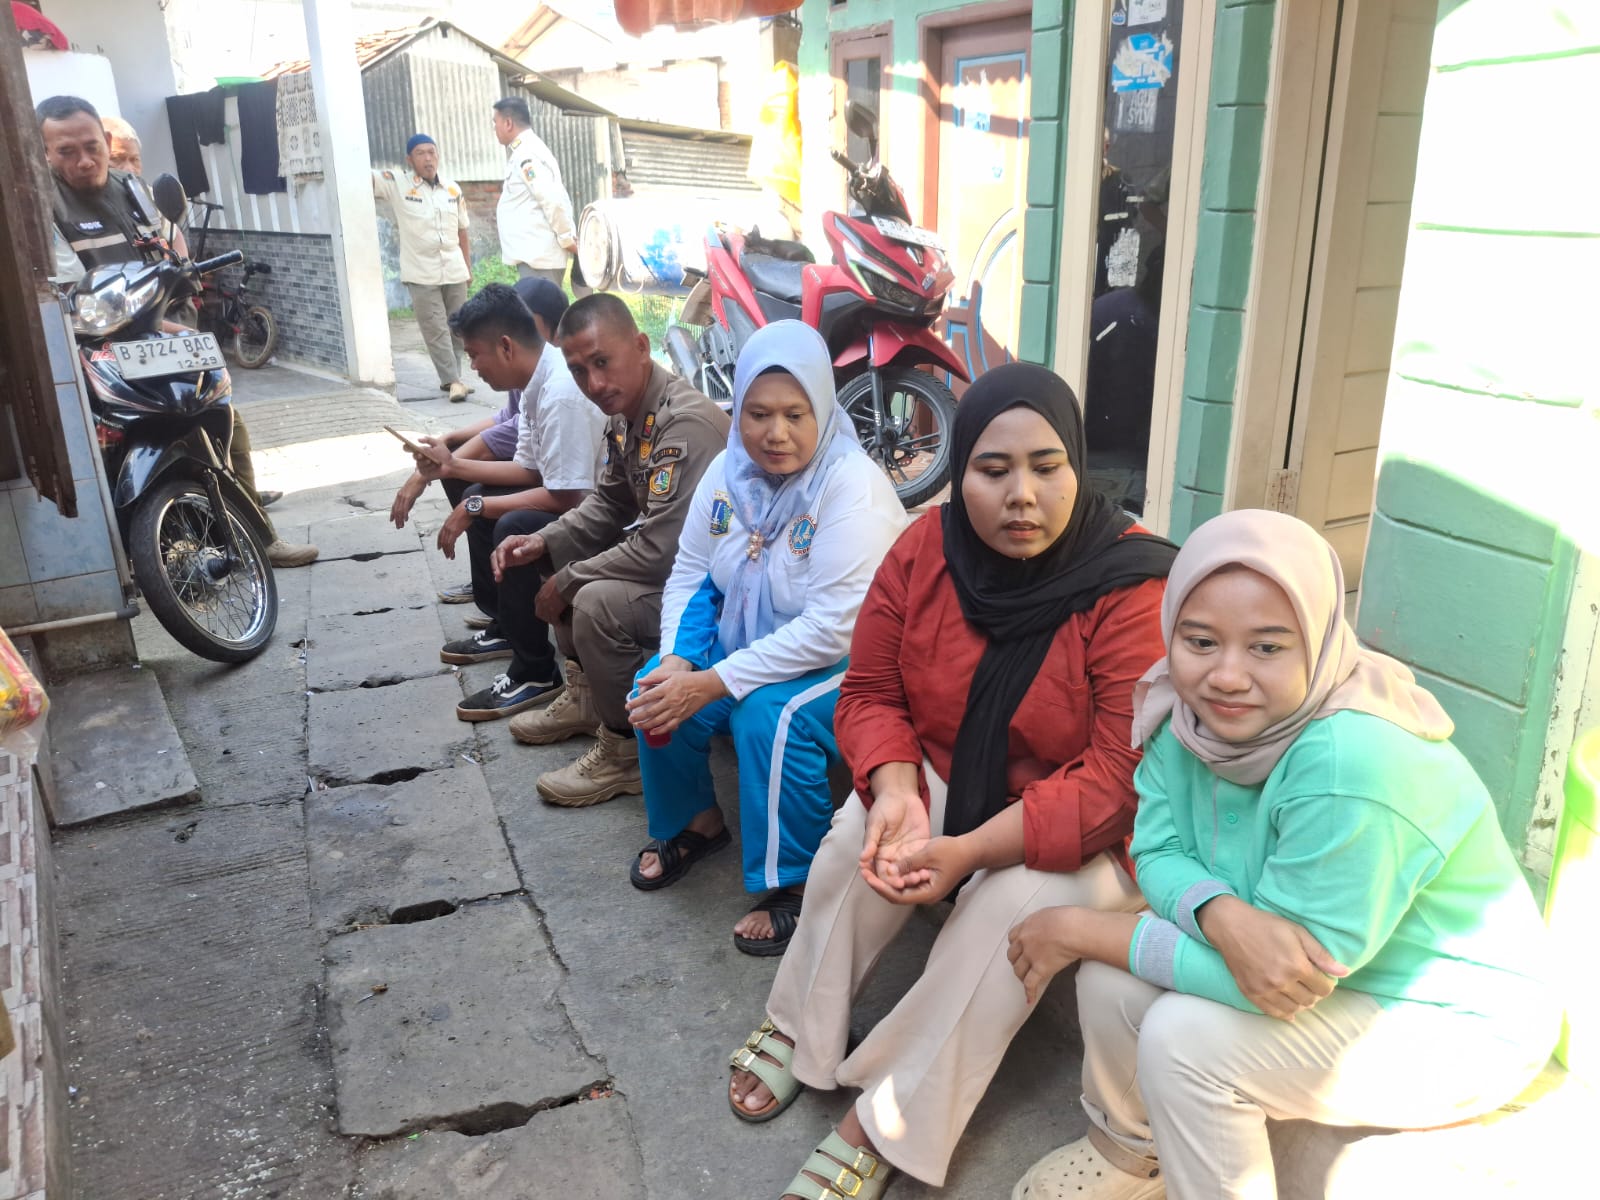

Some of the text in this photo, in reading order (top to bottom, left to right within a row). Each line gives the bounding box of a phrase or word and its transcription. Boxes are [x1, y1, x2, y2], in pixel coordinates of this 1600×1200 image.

[119, 346, 131, 361] B
[136, 341, 177, 359] 3724
[183, 336, 214, 353] BAC
